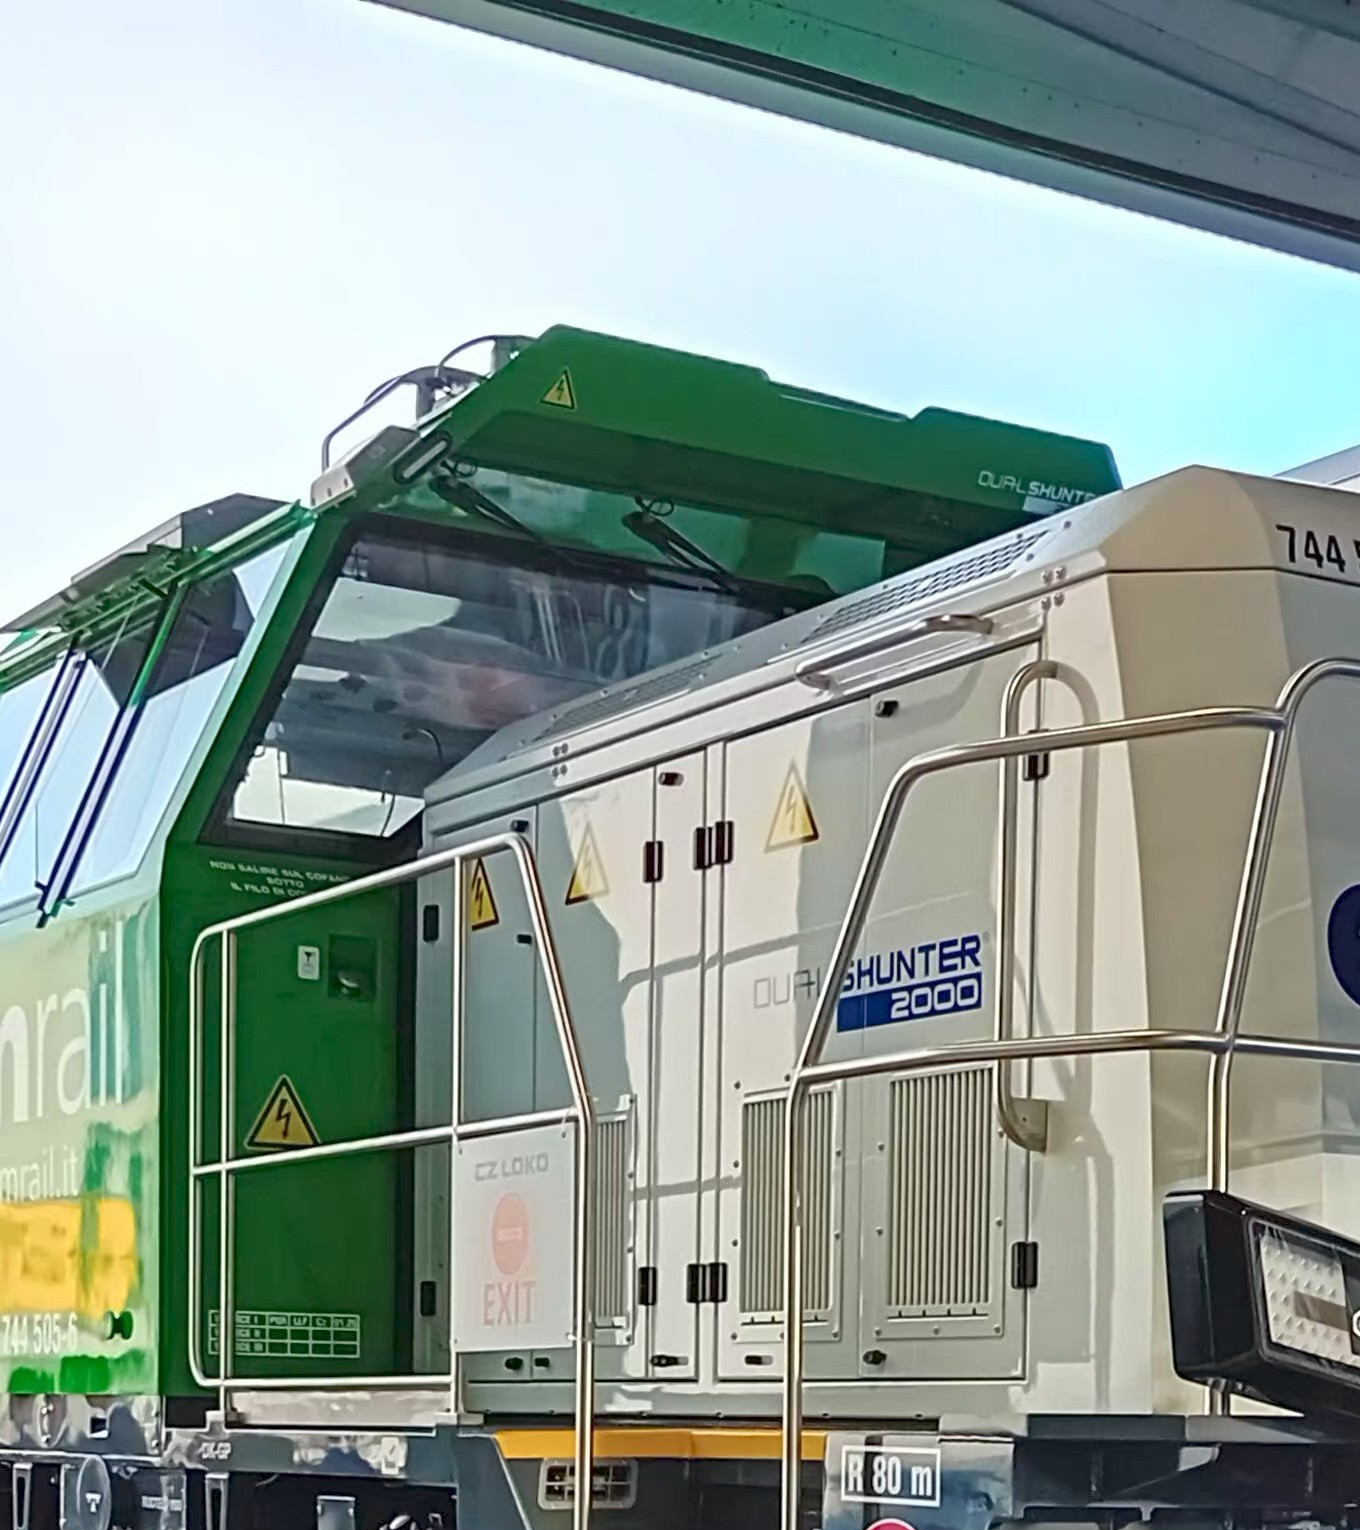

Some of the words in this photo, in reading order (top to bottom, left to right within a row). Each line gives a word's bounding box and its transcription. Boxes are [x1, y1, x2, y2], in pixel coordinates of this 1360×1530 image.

[978, 470, 1100, 503] DUALSHUNTE
[1276, 524, 1344, 573] 744
[890, 978, 980, 1020] 2000
[474, 1161, 498, 1182] CZ
[502, 1152, 549, 1178] LOKO
[483, 1280, 536, 1327] EXIT
[2, 1313, 29, 1354] 744
[33, 1311, 78, 1353] 505-6
[847, 1454, 864, 1492] R
[872, 1456, 902, 1495] 80
[910, 1465, 933, 1497] m
